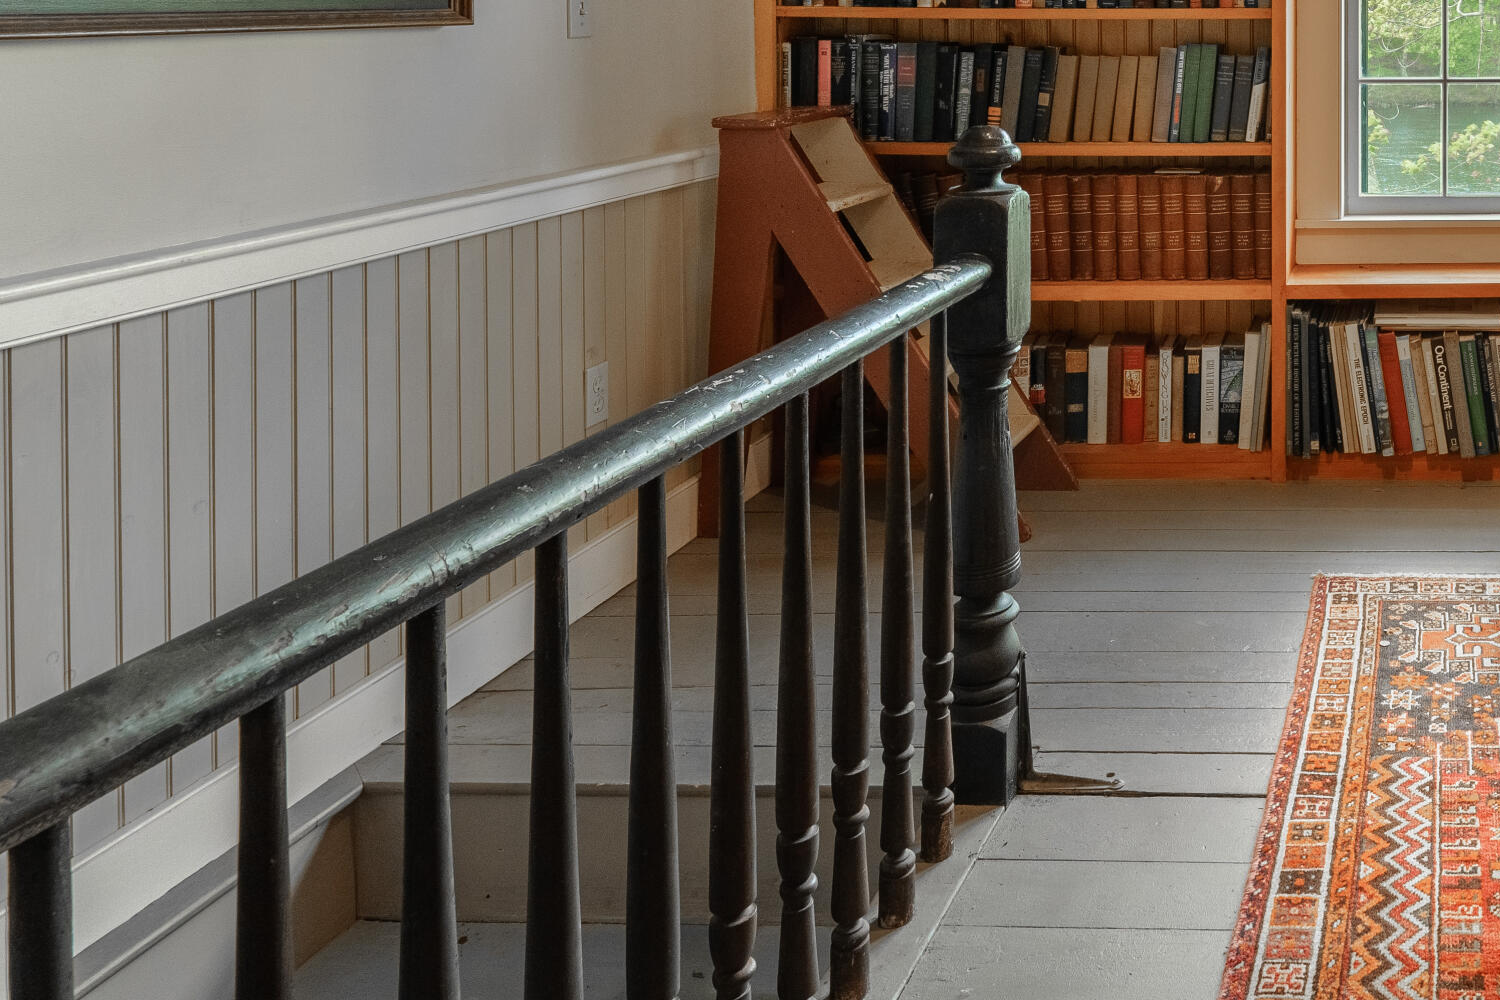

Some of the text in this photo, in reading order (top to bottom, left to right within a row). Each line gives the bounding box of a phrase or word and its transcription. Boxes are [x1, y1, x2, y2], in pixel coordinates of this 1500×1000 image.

[1355, 370, 1366, 404] ELECTRONIC
[1434, 344, 1452, 411] Our Continent
[1360, 405, 1369, 425] EPOCH
